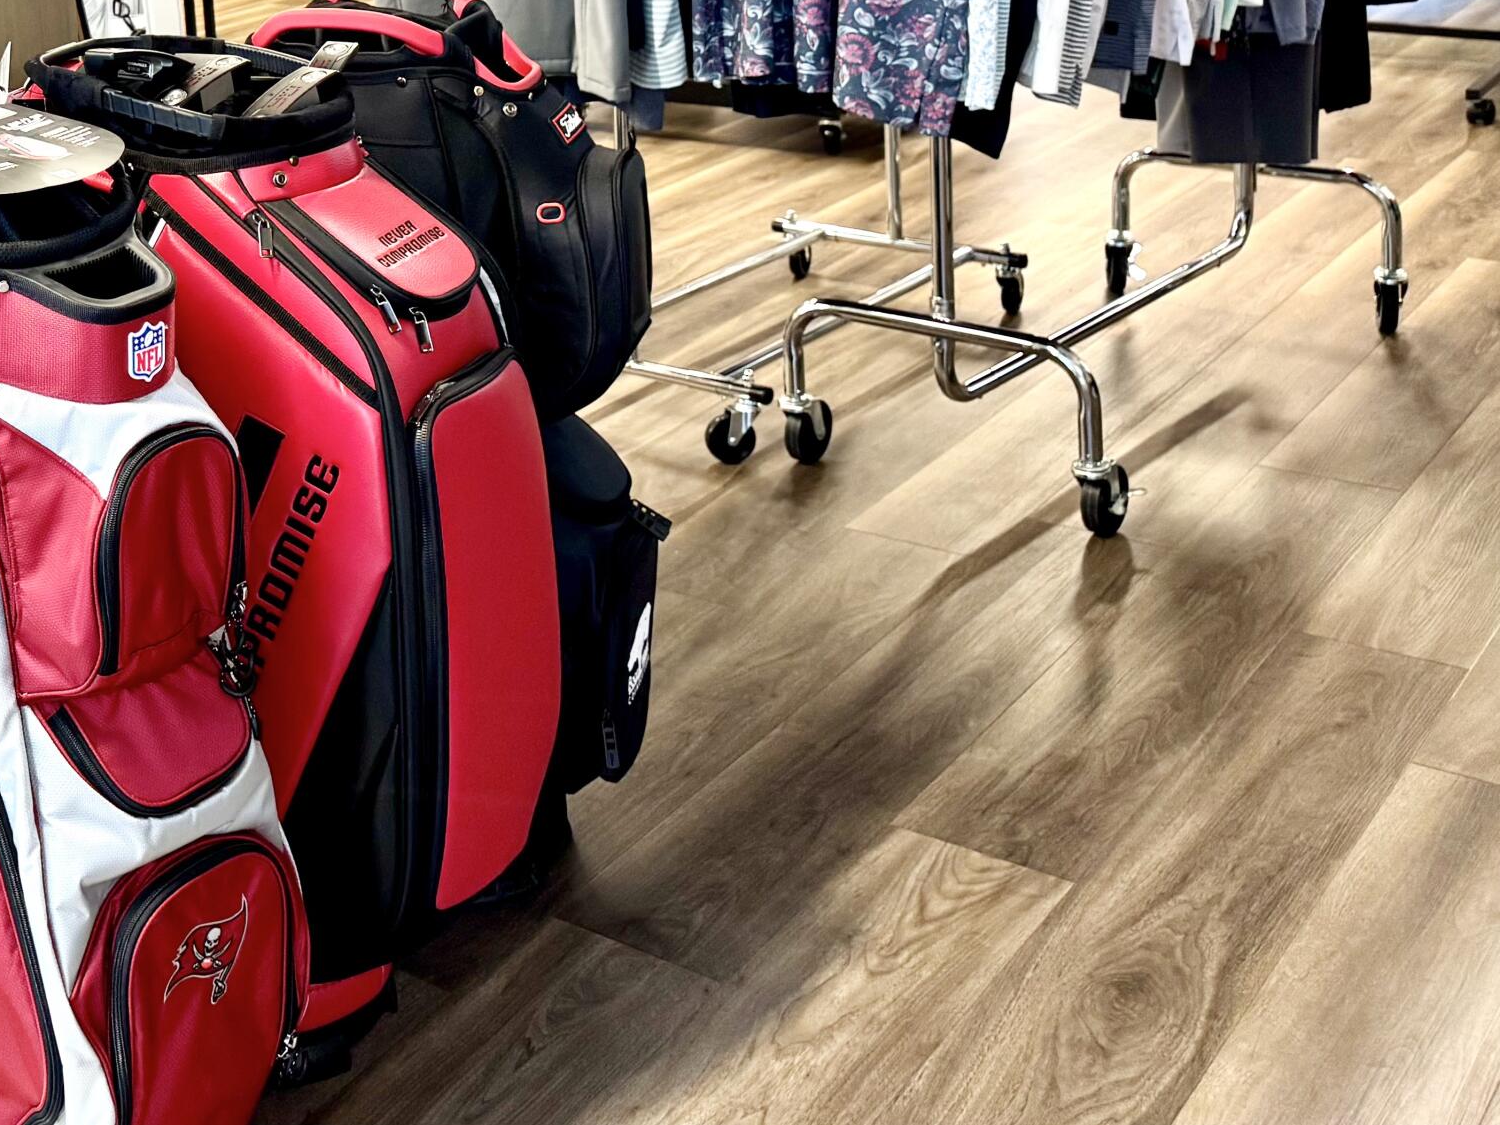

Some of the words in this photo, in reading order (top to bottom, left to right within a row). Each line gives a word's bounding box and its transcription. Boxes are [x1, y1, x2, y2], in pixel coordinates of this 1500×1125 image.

[377, 226, 446, 268] COMPROMISE
[378, 219, 417, 247] NEVER
[136, 346, 162, 372] NFL
